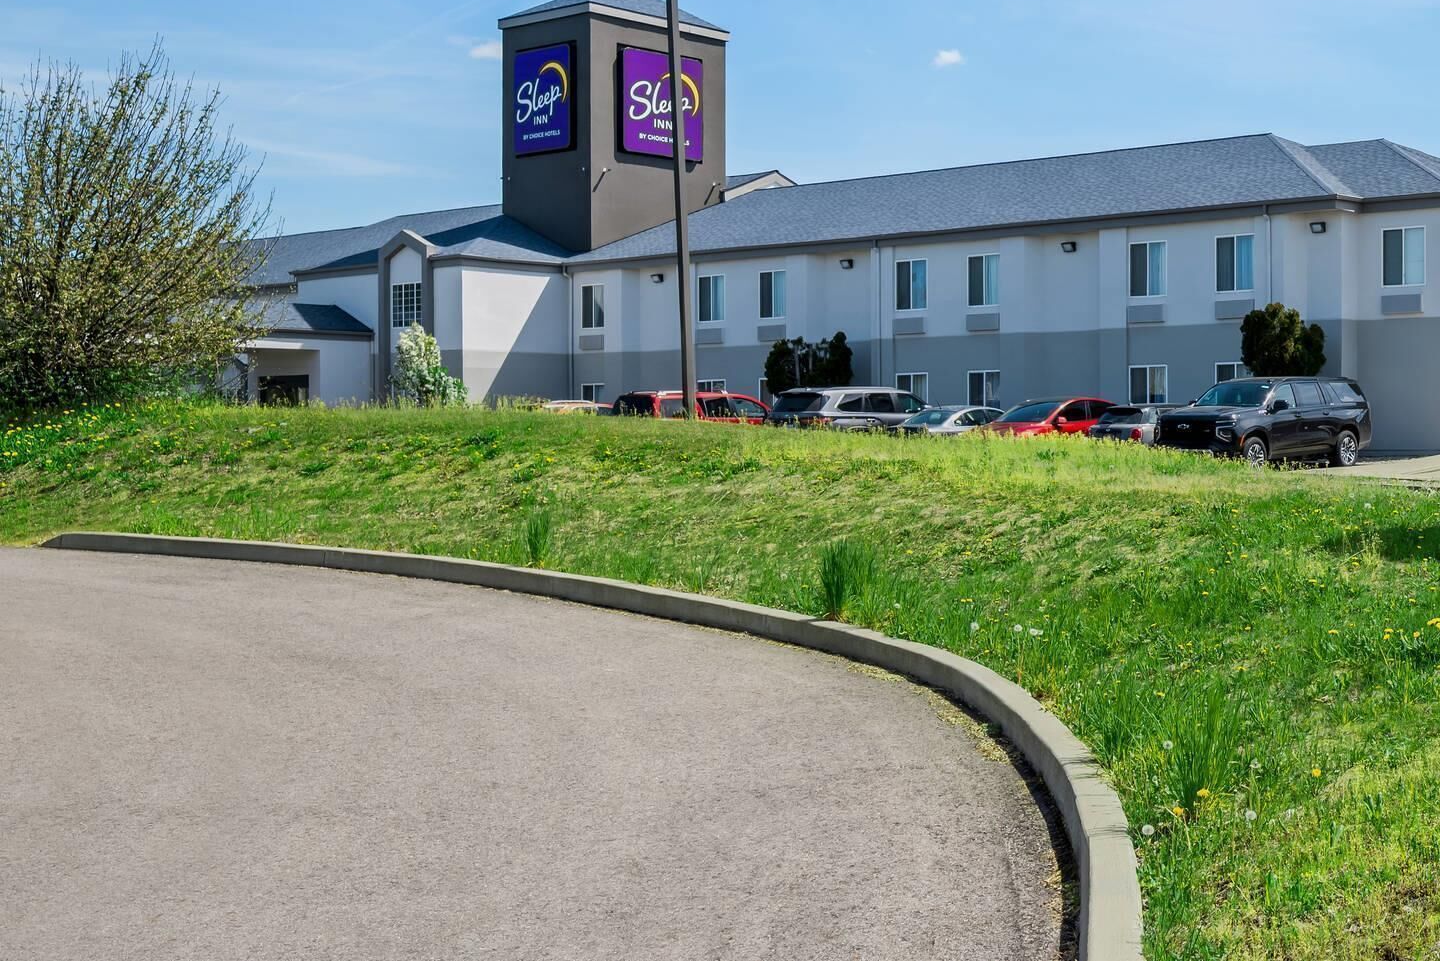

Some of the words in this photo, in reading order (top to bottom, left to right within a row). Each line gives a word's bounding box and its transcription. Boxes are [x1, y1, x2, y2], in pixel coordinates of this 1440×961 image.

[516, 78, 562, 123] Sleep
[629, 80, 692, 120] Sle
[533, 114, 548, 126] INN
[647, 133, 669, 143] CHOICE
